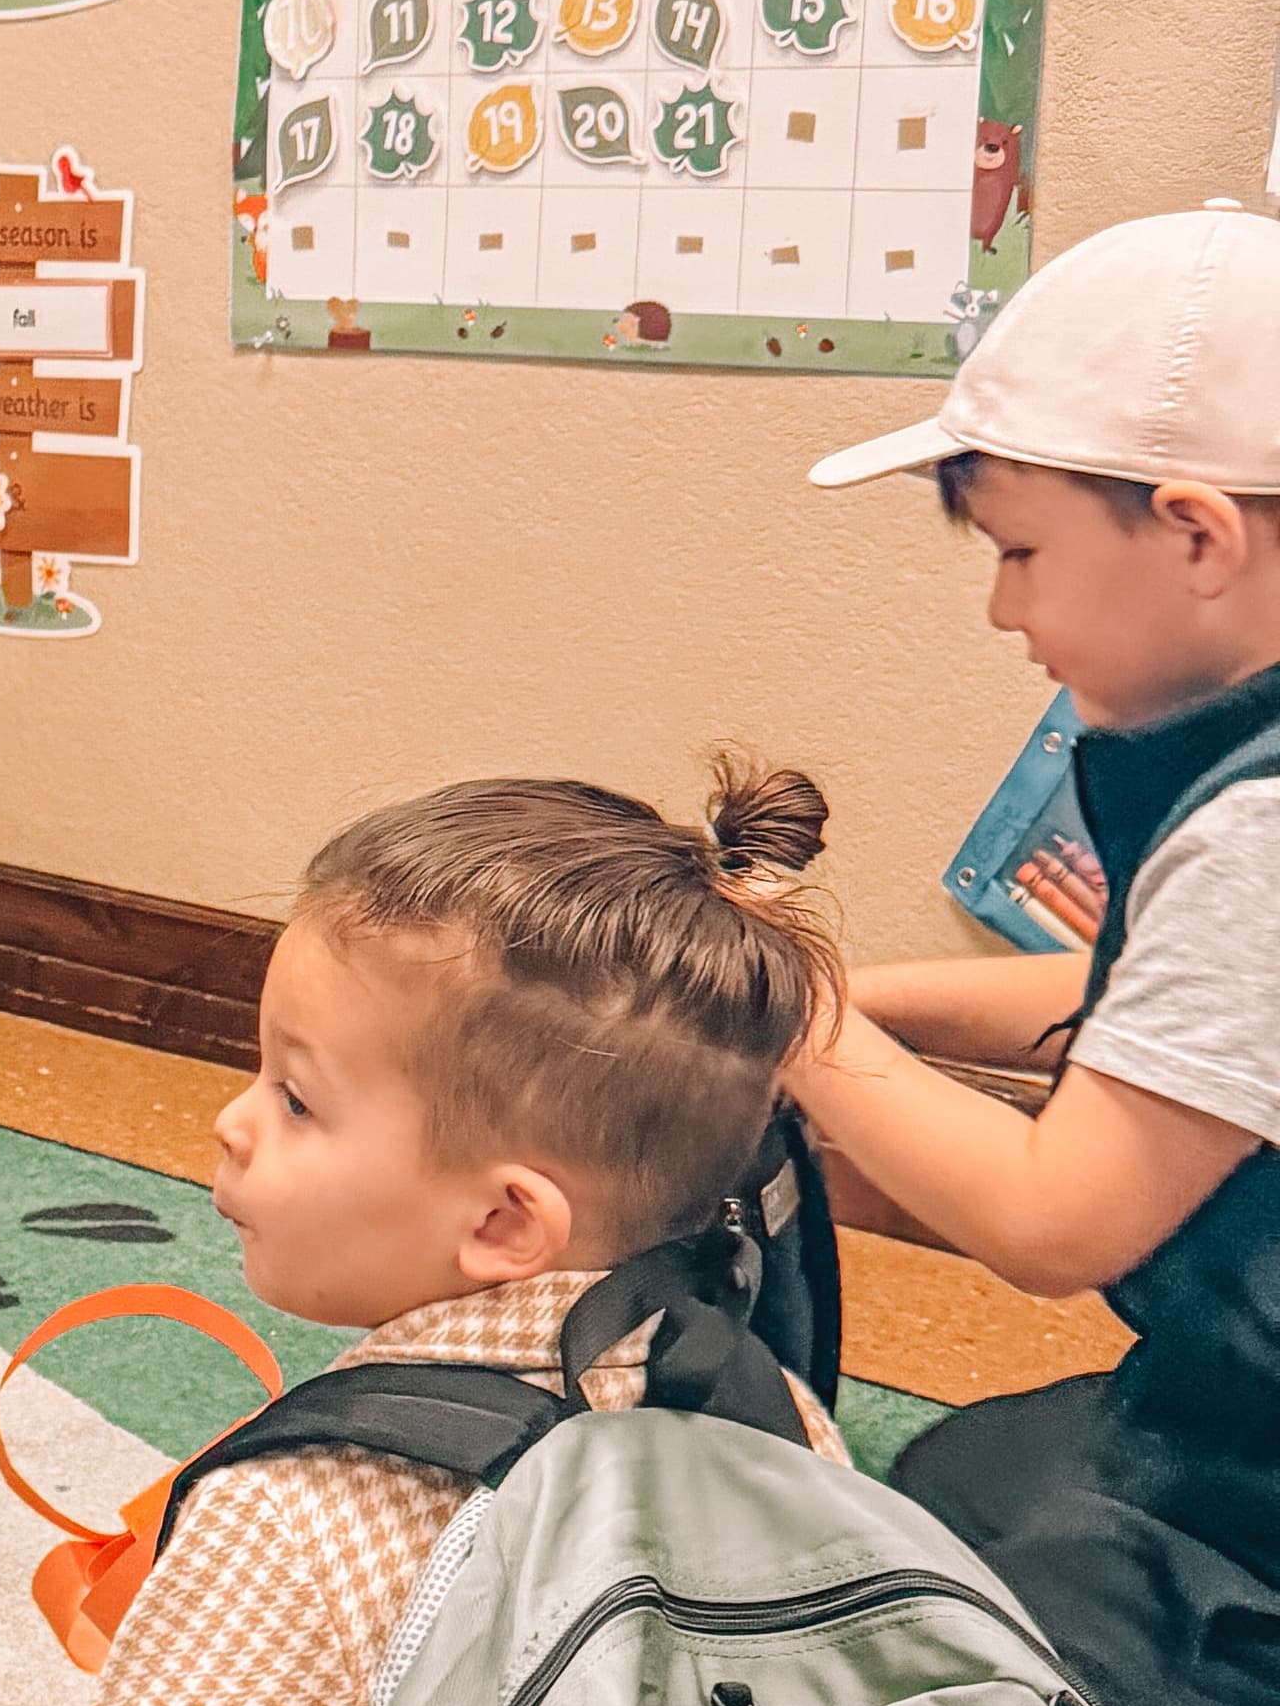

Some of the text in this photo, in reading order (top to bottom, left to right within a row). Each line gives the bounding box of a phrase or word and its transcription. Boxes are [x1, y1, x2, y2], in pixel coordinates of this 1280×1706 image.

[383, 0, 415, 43] 11
[477, 0, 518, 45] 12
[670, 0, 711, 51] 14
[288, 101, 715, 161] 17 18 19 20 21
[0, 224, 71, 248] season
[80, 223, 98, 249] is
[12, 308, 36, 329] fall
[79, 396, 97, 423] is
